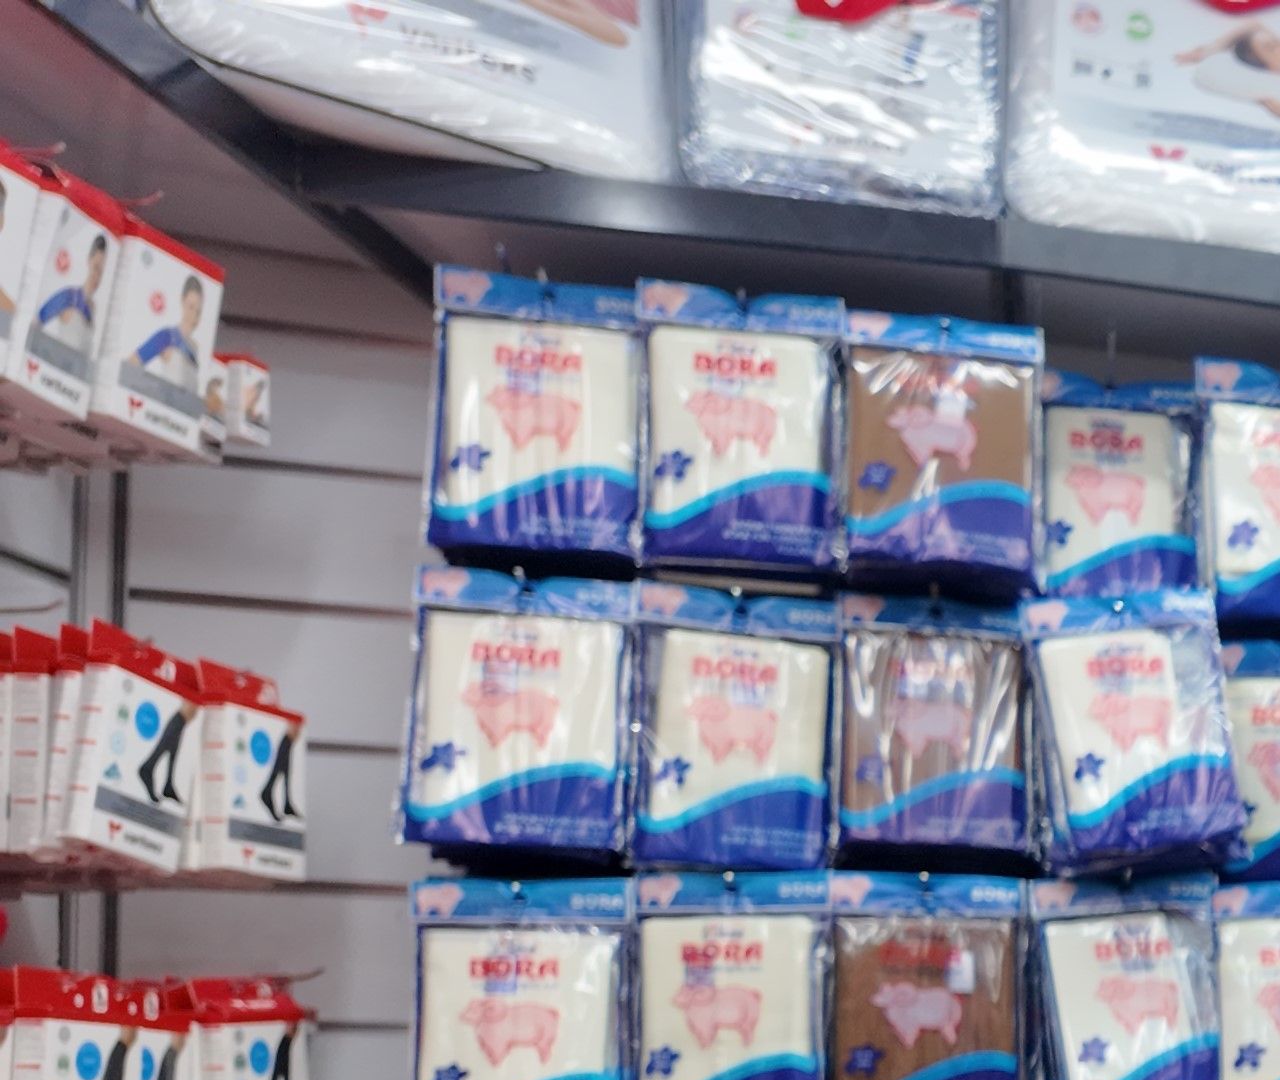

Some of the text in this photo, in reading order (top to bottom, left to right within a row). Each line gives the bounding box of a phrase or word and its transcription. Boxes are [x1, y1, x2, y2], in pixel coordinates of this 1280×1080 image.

[694, 353, 776, 377] BORA
[471, 642, 561, 670] BORA
[692, 657, 777, 683] BORA
[681, 942, 763, 964] BORA
[470, 956, 558, 979] BORA
